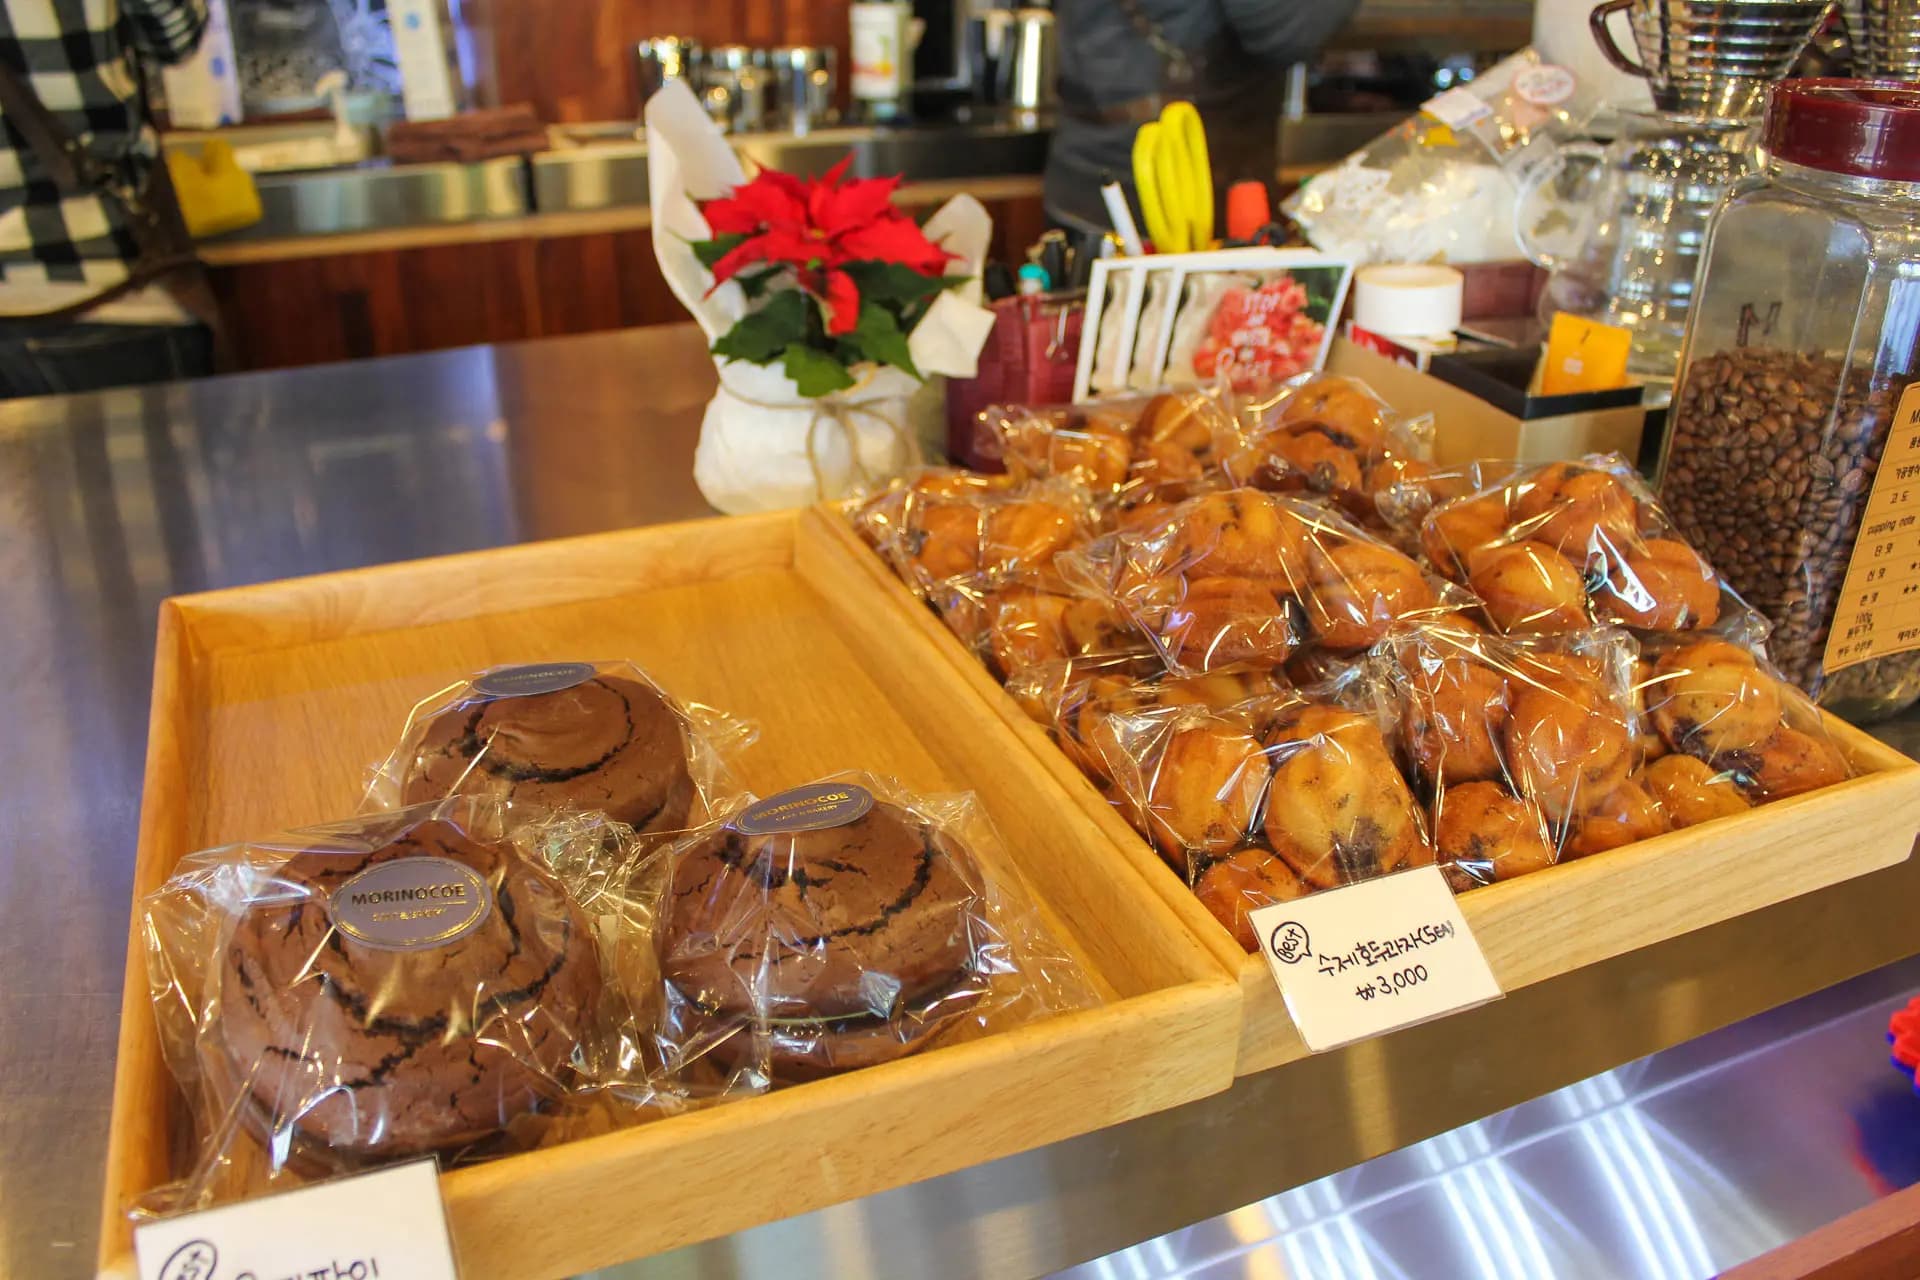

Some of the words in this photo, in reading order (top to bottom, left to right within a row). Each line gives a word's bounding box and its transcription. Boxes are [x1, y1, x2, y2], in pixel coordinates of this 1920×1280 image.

[1867, 520, 1896, 535] cupping
[1899, 515, 1916, 527] note
[752, 792, 849, 822] MORINOCOE
[351, 884, 467, 905] MORINOCOE
[1355, 964, 1429, 1000] ₩3,000
